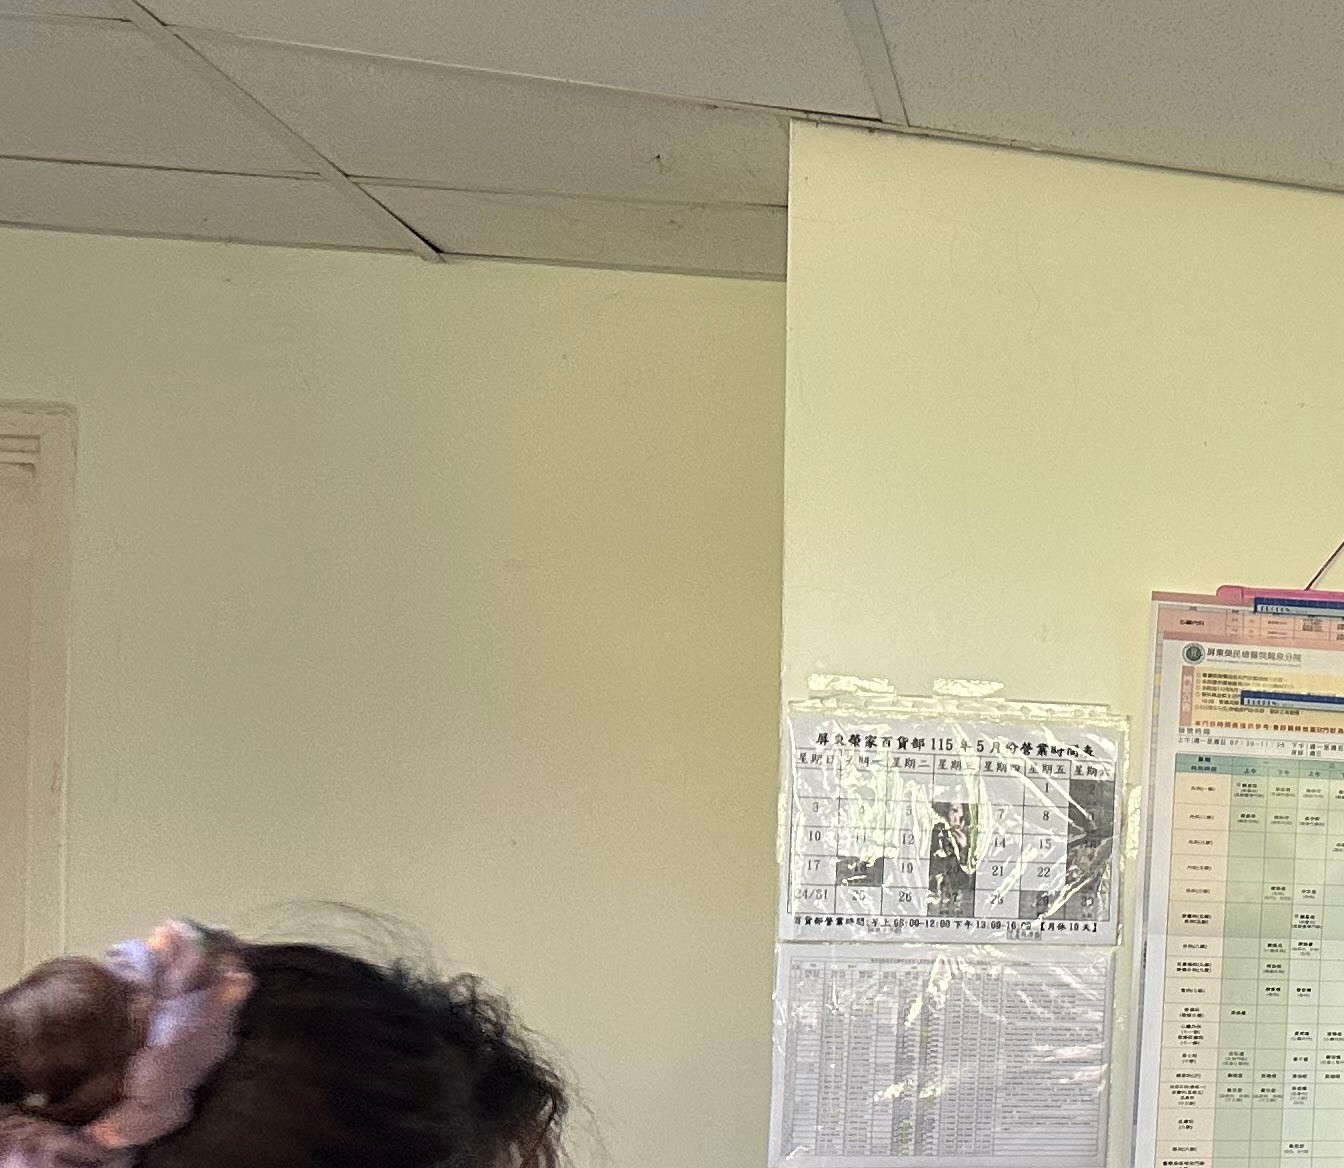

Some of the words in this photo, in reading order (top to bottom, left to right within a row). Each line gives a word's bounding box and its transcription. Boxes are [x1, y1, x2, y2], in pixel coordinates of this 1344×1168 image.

[931, 738, 953, 751] 115
[808, 831, 821, 841] 10
[807, 860, 820, 870] 17
[992, 866, 1004, 876] 21
[1037, 868, 1050, 877] 22
